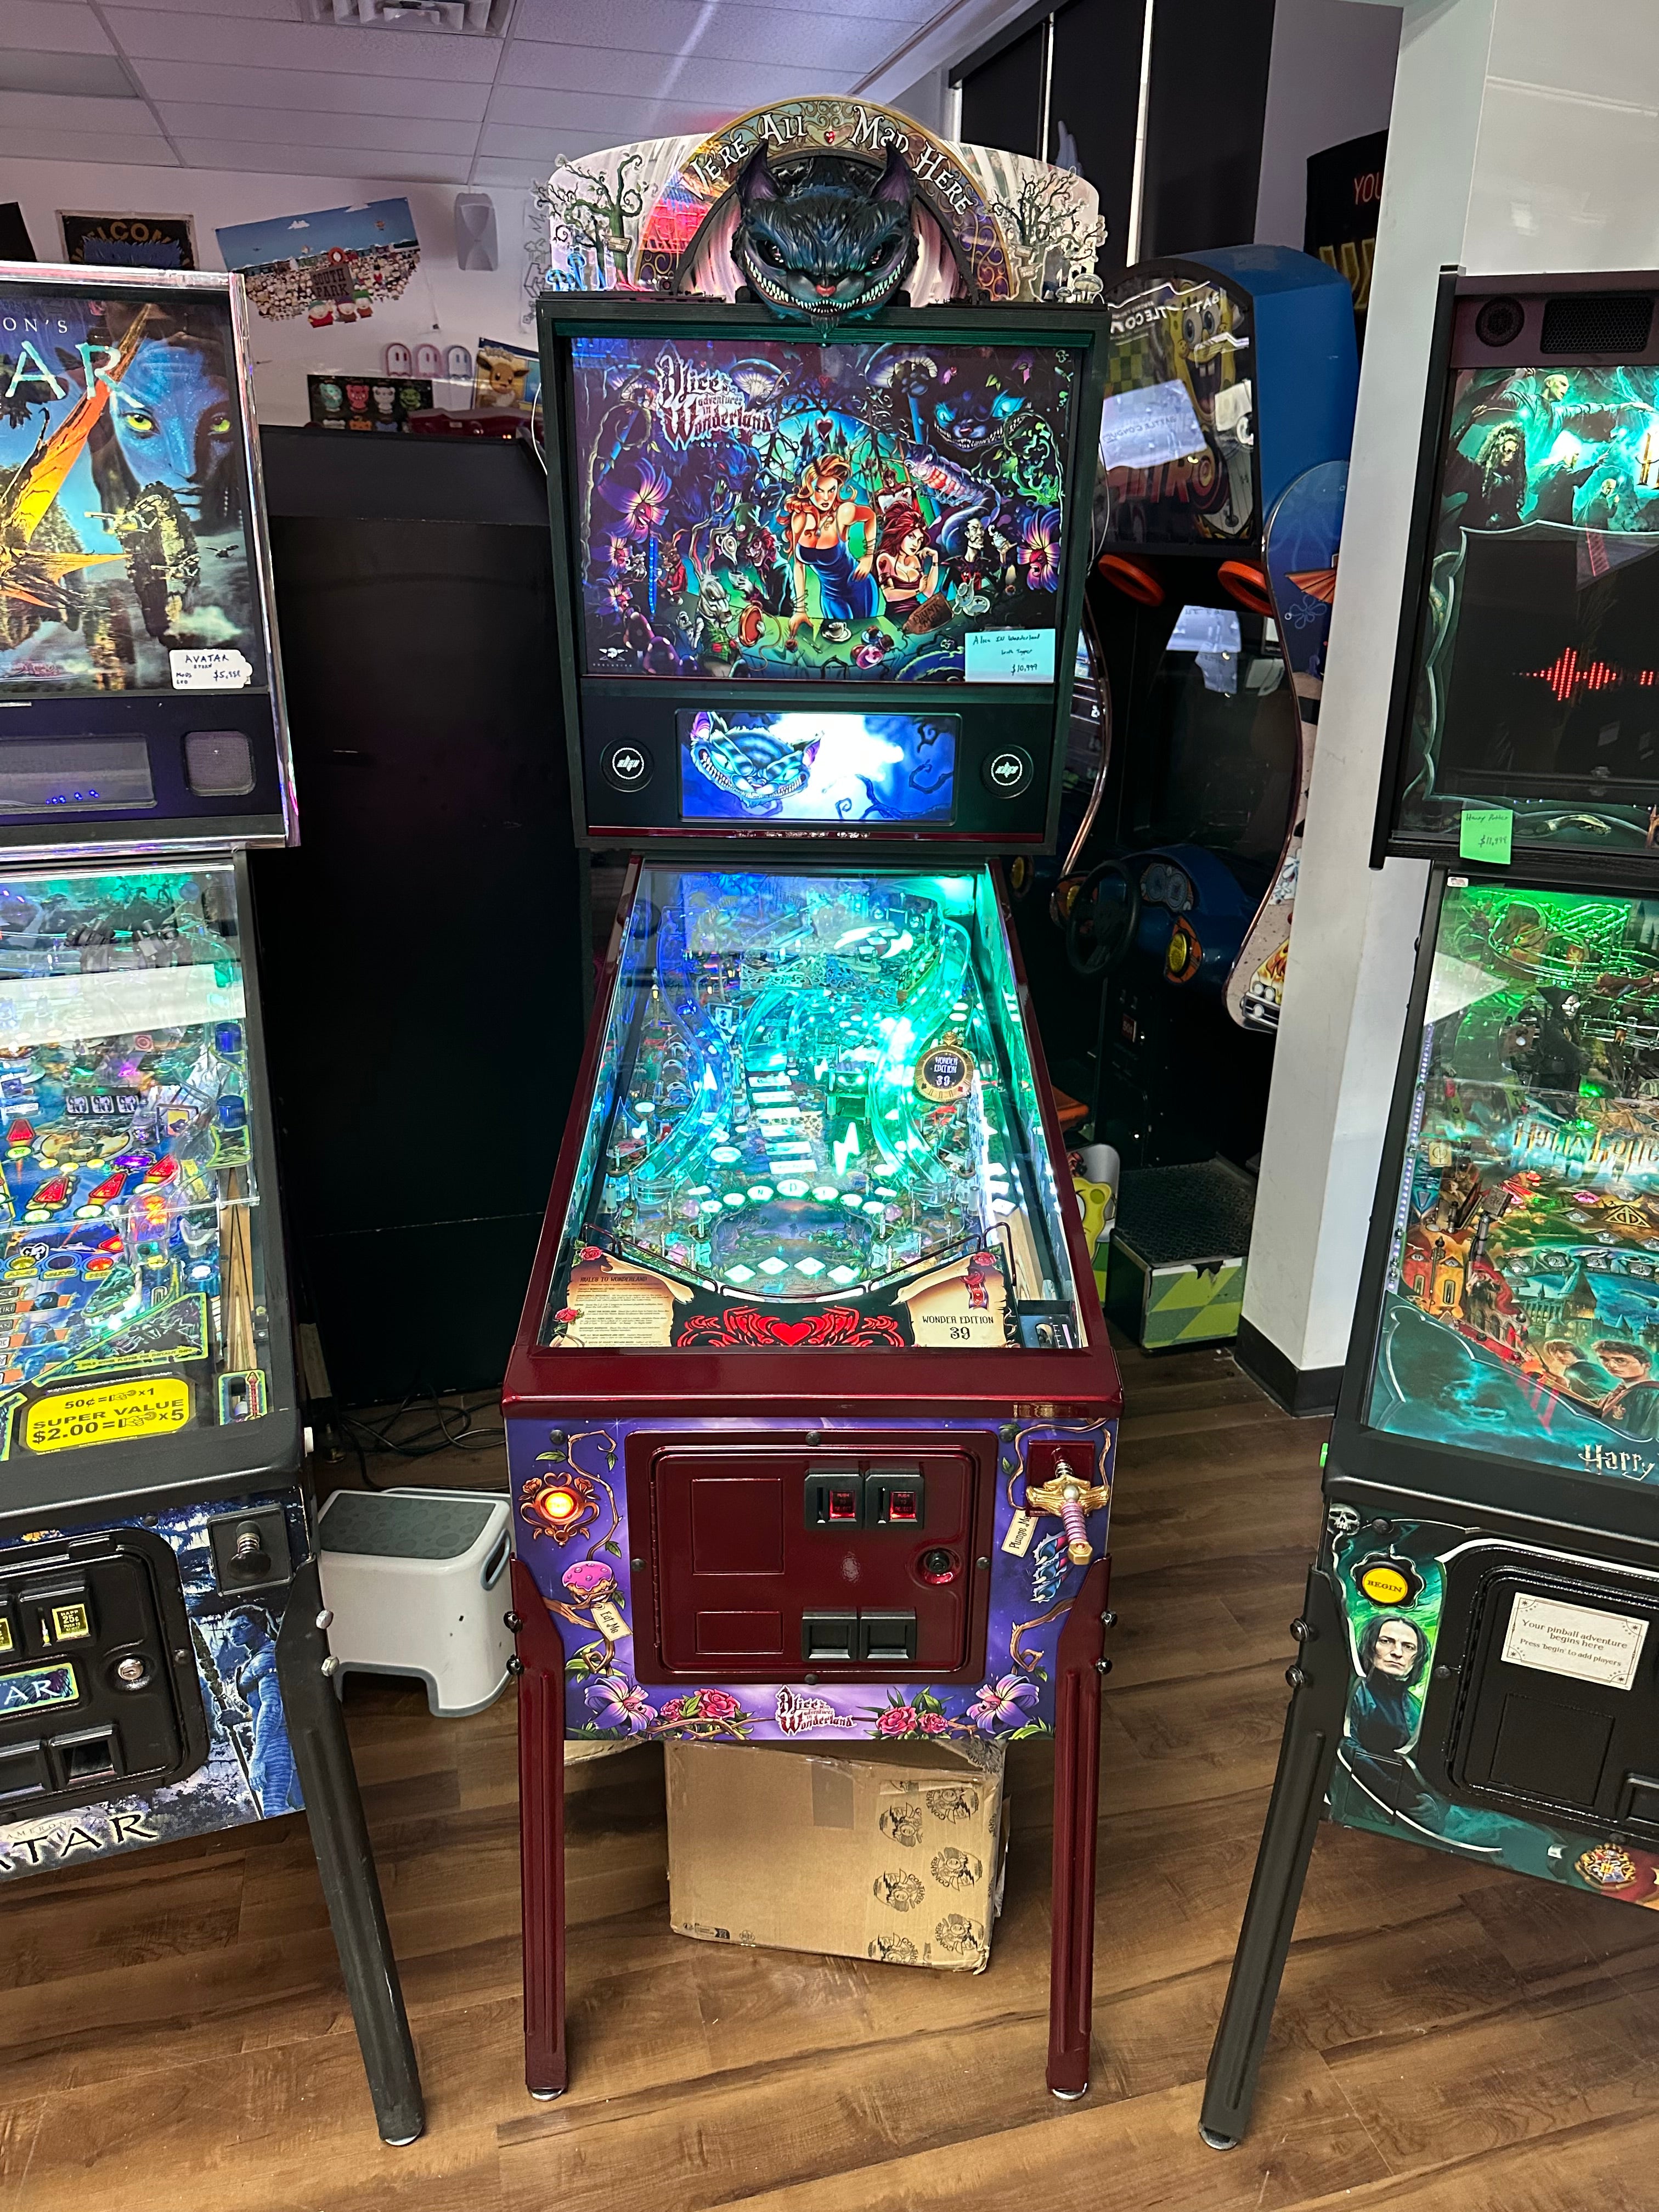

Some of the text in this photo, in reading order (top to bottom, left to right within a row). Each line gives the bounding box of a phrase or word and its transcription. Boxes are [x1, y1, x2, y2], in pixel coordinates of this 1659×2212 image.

[313, 268, 346, 285] SOUTH
[316, 284, 349, 297] PARK
[185, 654, 229, 663] AVATAR
[1011, 664, 1037, 676] $10,999
[1466, 814, 1486, 823] Harry
[936, 1075, 950, 1086] 39
[950, 1327, 970, 1340] 39
[33, 1399, 184, 1429] SUPER VALUE
[1579, 1444, 1655, 1480] Harry
[1009, 1528, 1027, 1549] Plunge
[1367, 1580, 1402, 1593] BEGIN
[600, 1611, 614, 1623] Eat
[606, 1623, 620, 1633] Me
[1522, 1620, 1627, 1648] Your pinball adventure
[1550, 1633, 1603, 1650] begins here
[1520, 1639, 1540, 1648] Press
[1593, 1656, 1621, 1666] players
